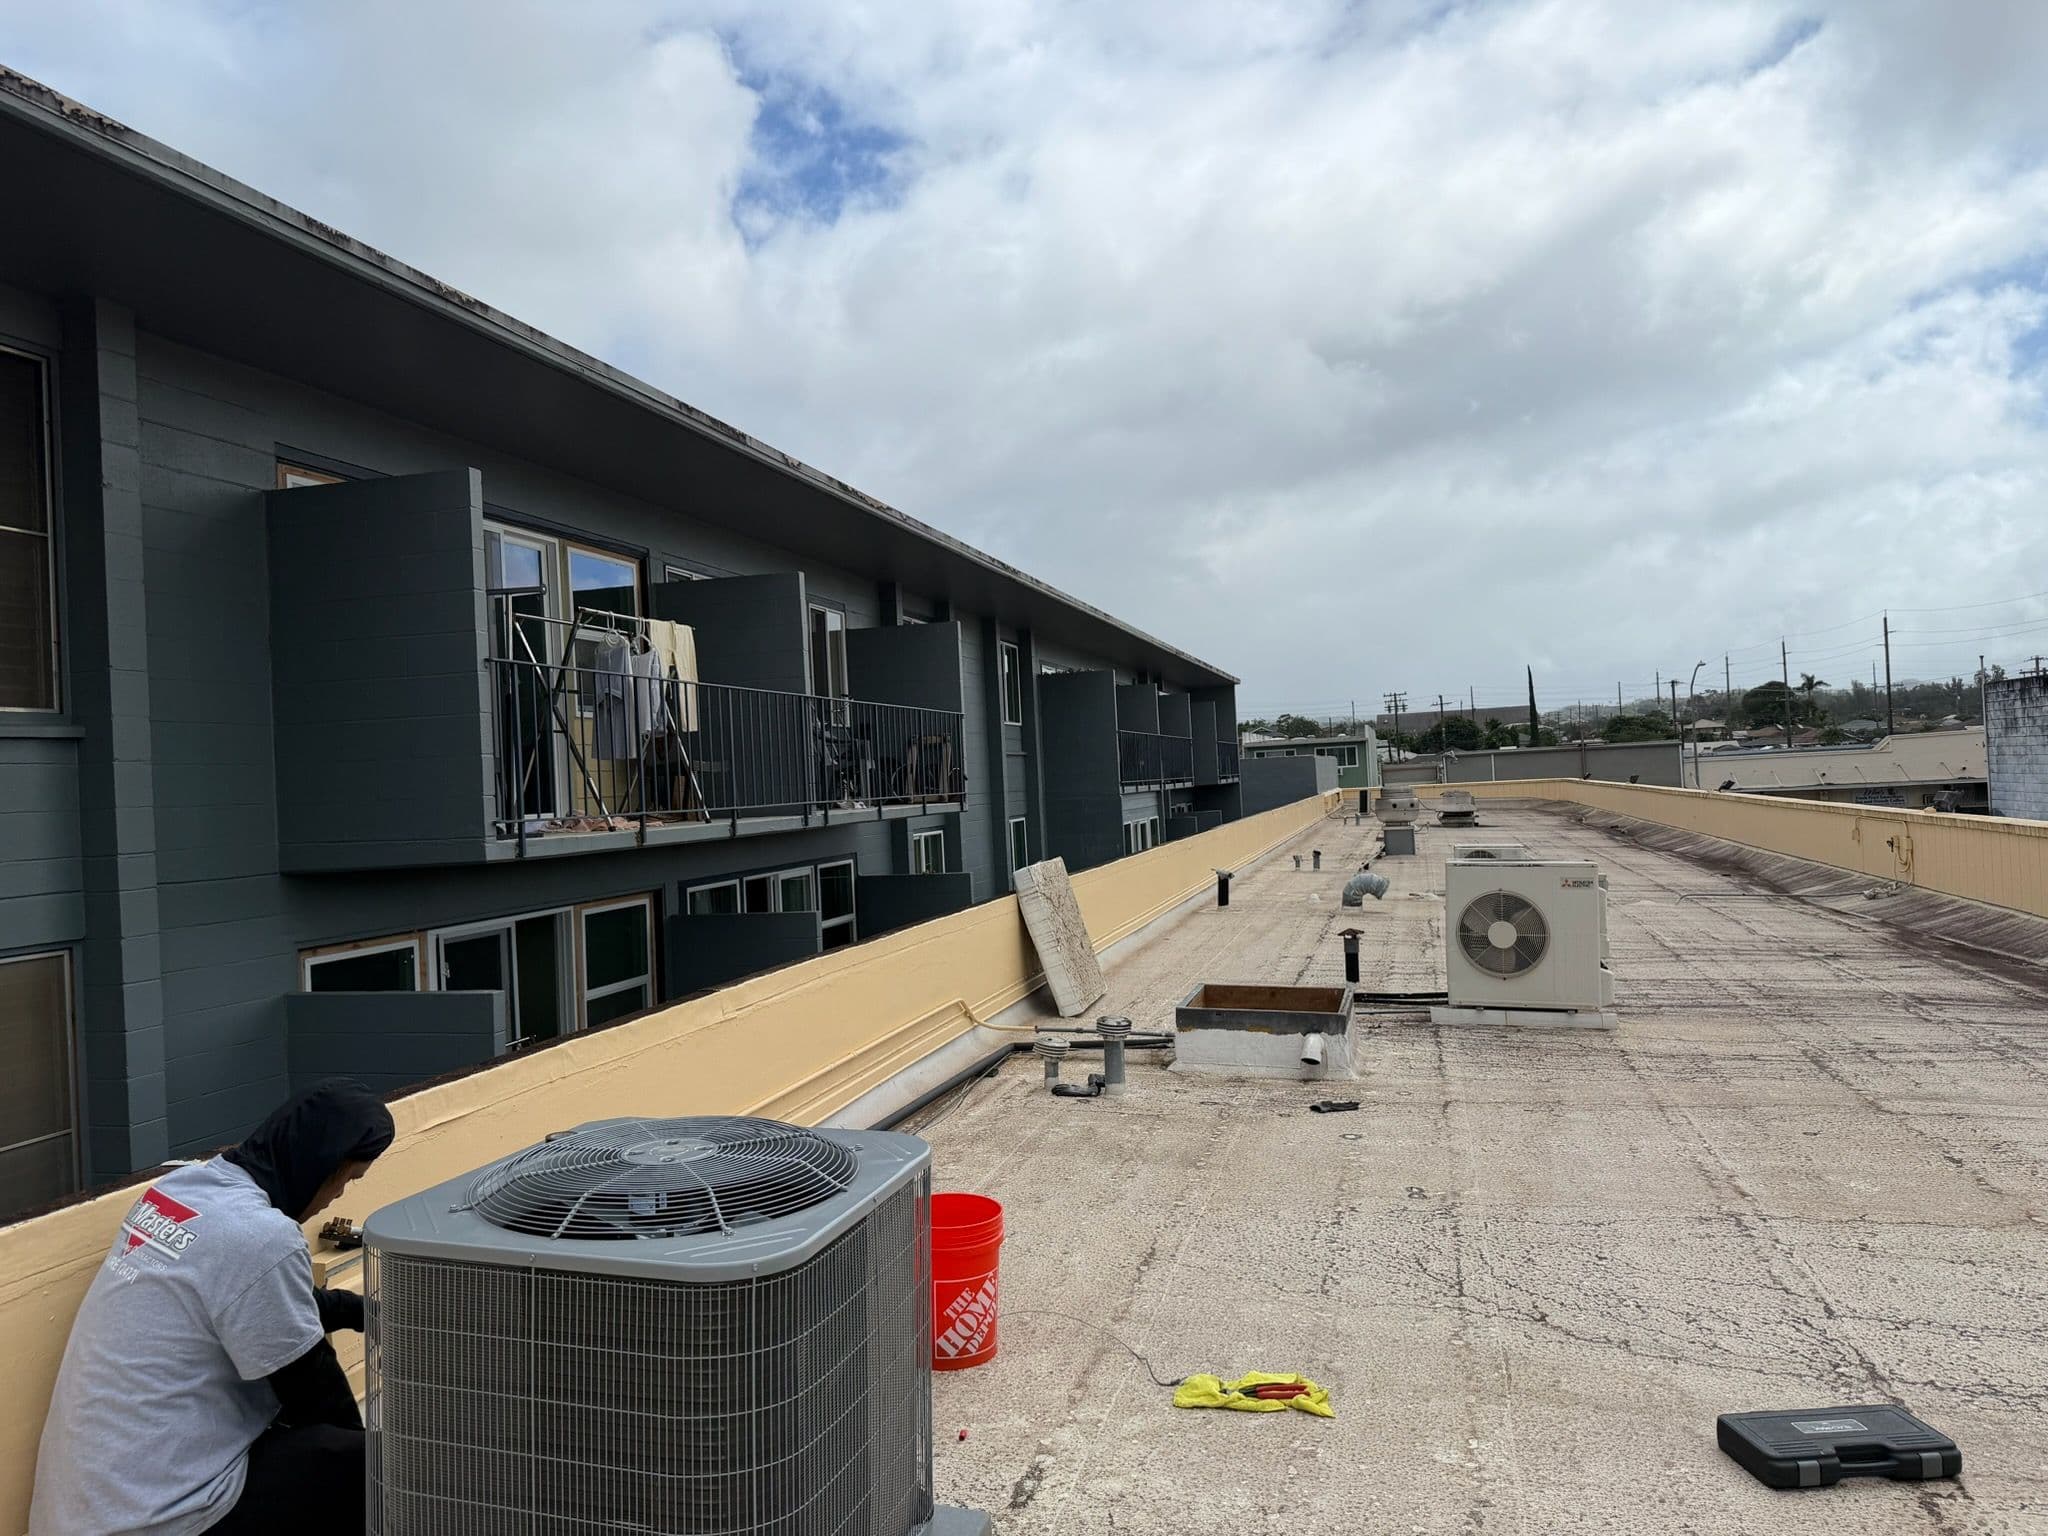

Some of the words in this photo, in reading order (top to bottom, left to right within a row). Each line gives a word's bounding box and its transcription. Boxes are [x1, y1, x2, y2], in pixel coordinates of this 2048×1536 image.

[129, 1202, 198, 1250] Masters
[936, 1271, 997, 1357] HOME
[943, 1287, 975, 1321] THE
